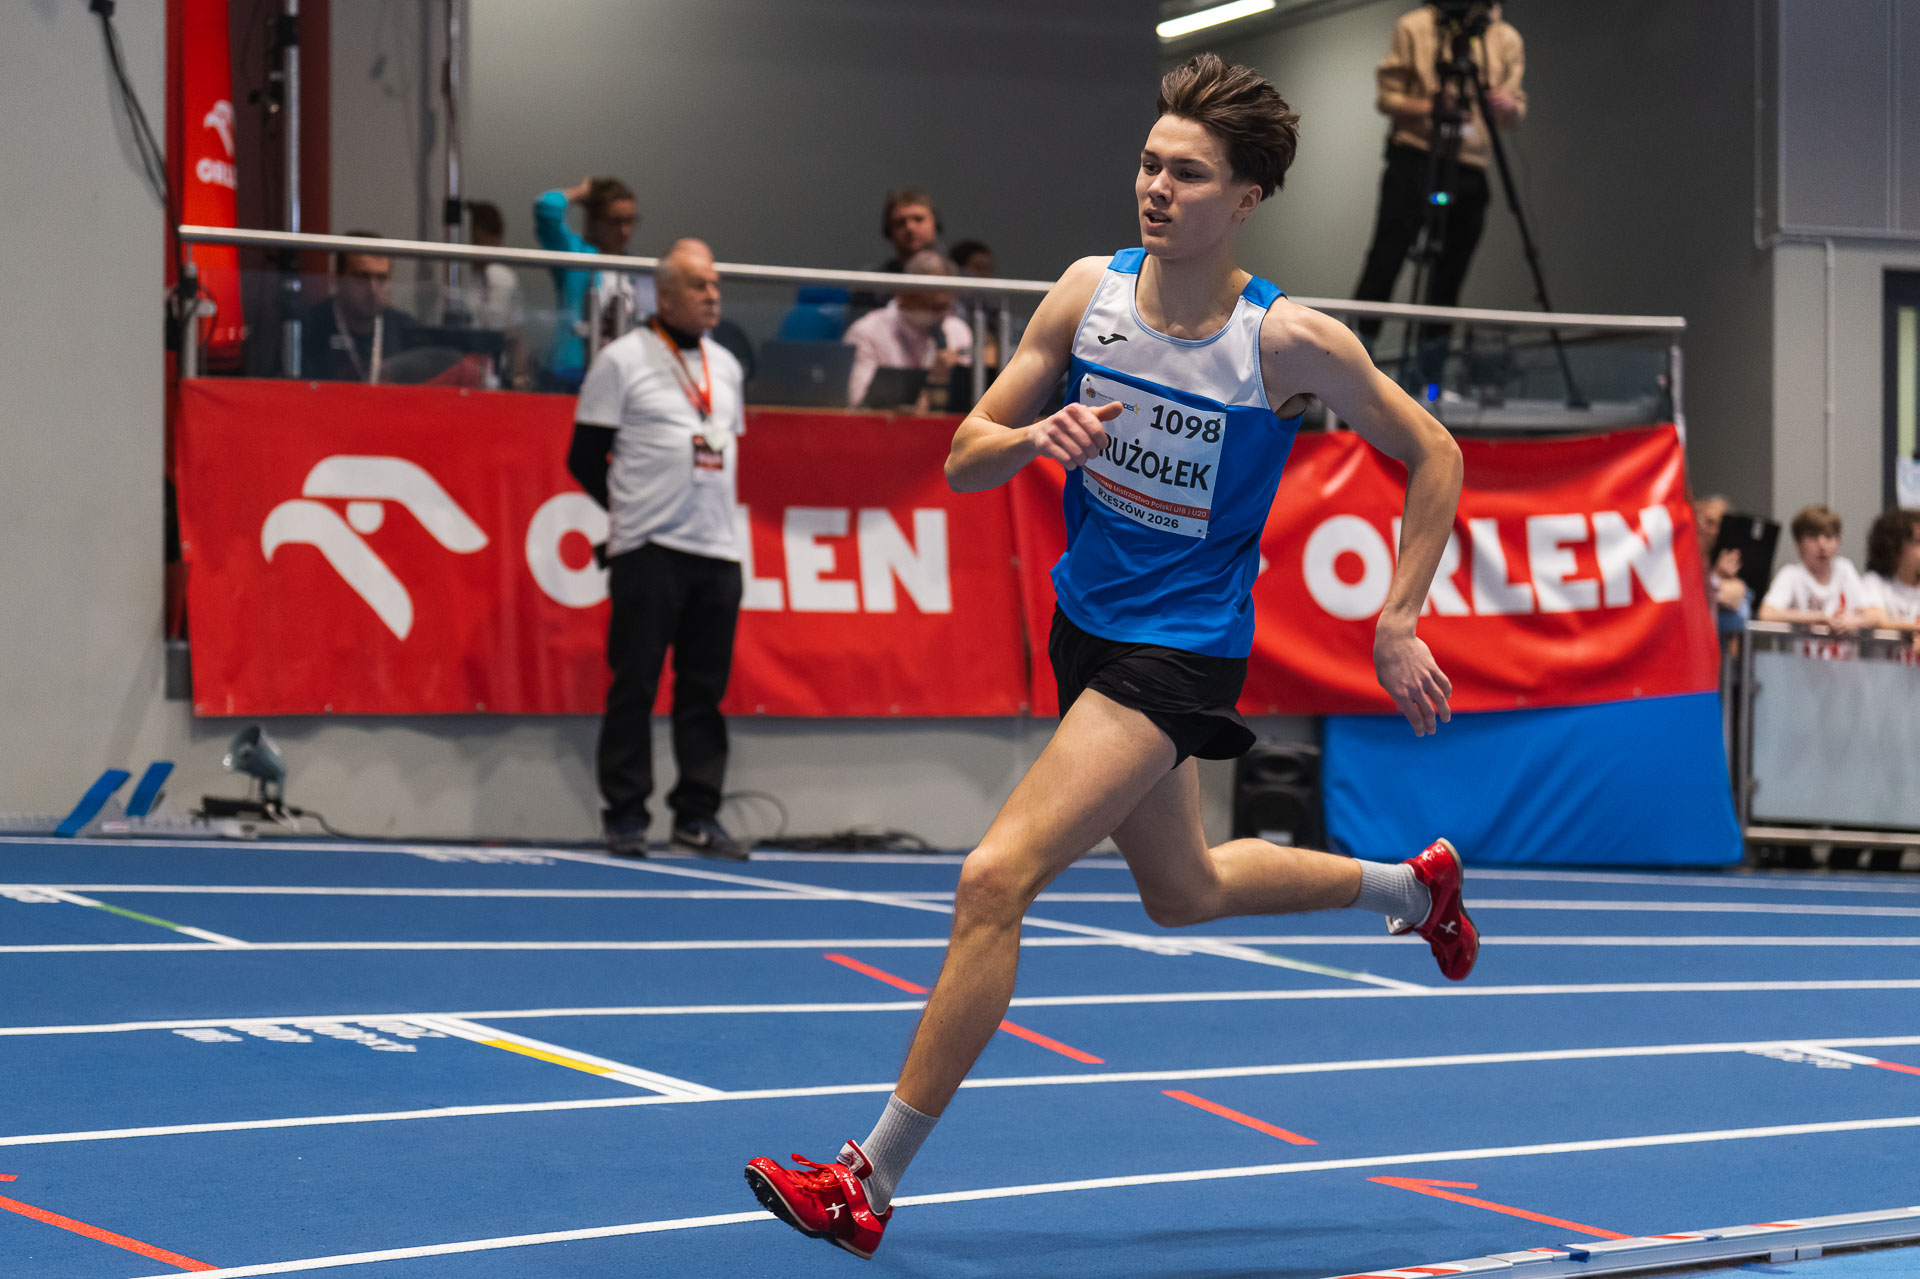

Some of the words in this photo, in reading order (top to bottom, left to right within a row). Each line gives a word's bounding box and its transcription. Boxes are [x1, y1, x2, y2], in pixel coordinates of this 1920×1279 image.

[1150, 404, 1221, 443] 1098
[1098, 487, 1146, 519] RZESZÓW
[1148, 513, 1179, 529] 2026
[1113, 484, 1150, 506] Mistrzostwa
[1150, 501, 1172, 512] Polski
[1192, 508, 1207, 518] U20
[525, 491, 952, 613] OLEN
